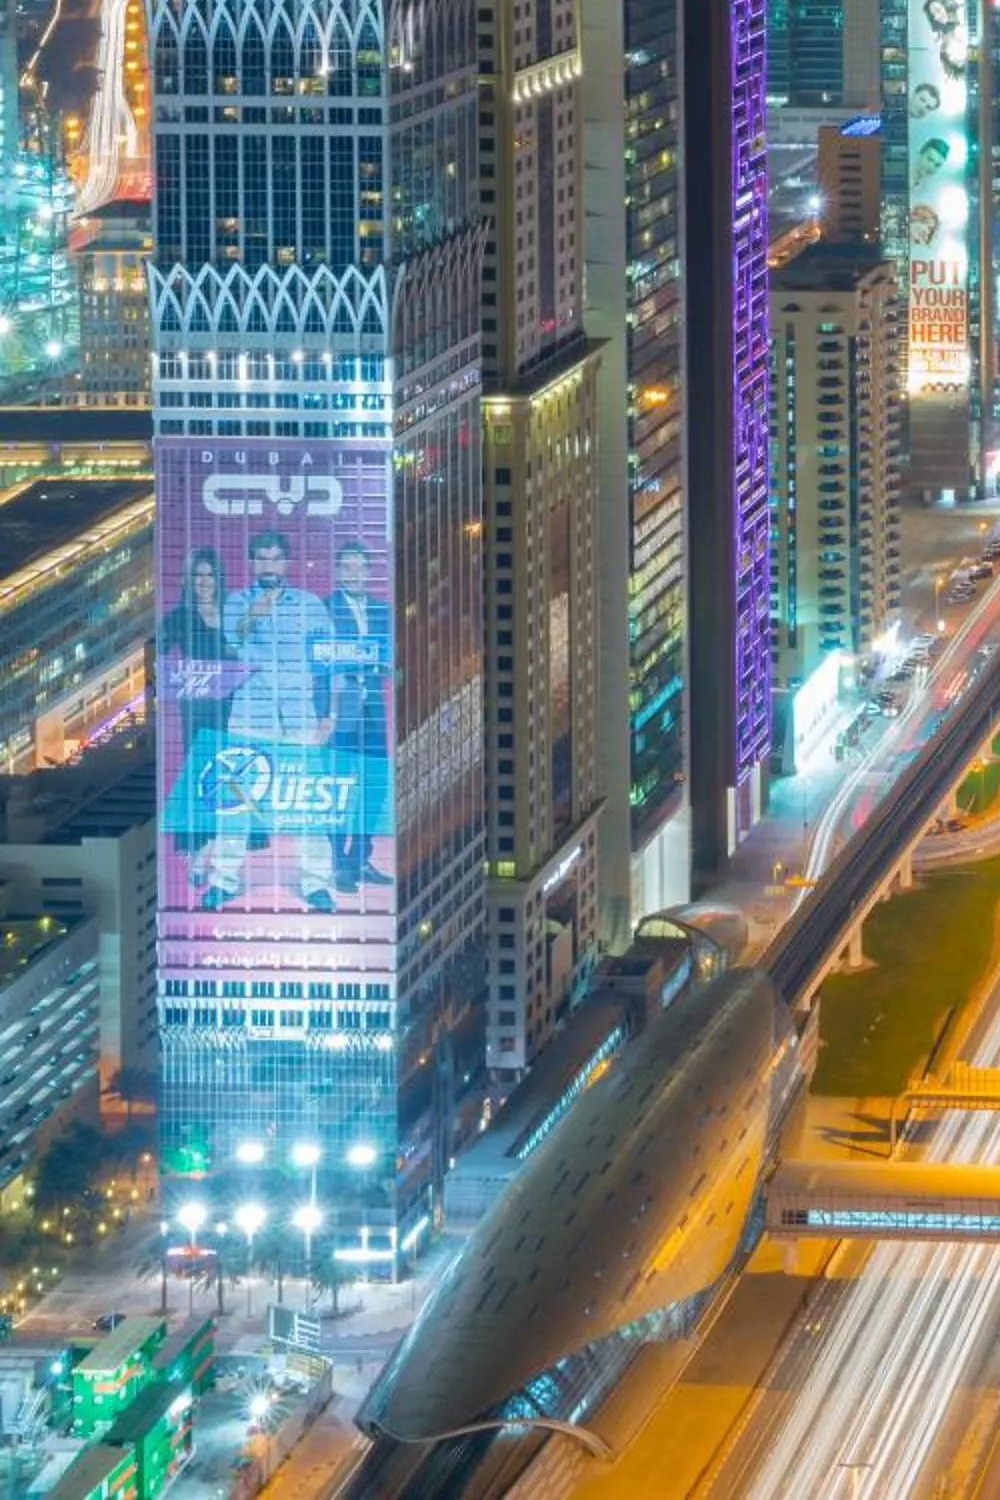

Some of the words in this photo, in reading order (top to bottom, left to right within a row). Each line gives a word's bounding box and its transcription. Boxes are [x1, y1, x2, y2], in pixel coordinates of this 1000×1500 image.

[912, 288, 964, 306] YOUR
[912, 308, 964, 322] BRAND
[912, 323, 964, 343] HERE
[202, 452, 344, 465] DUBAI
